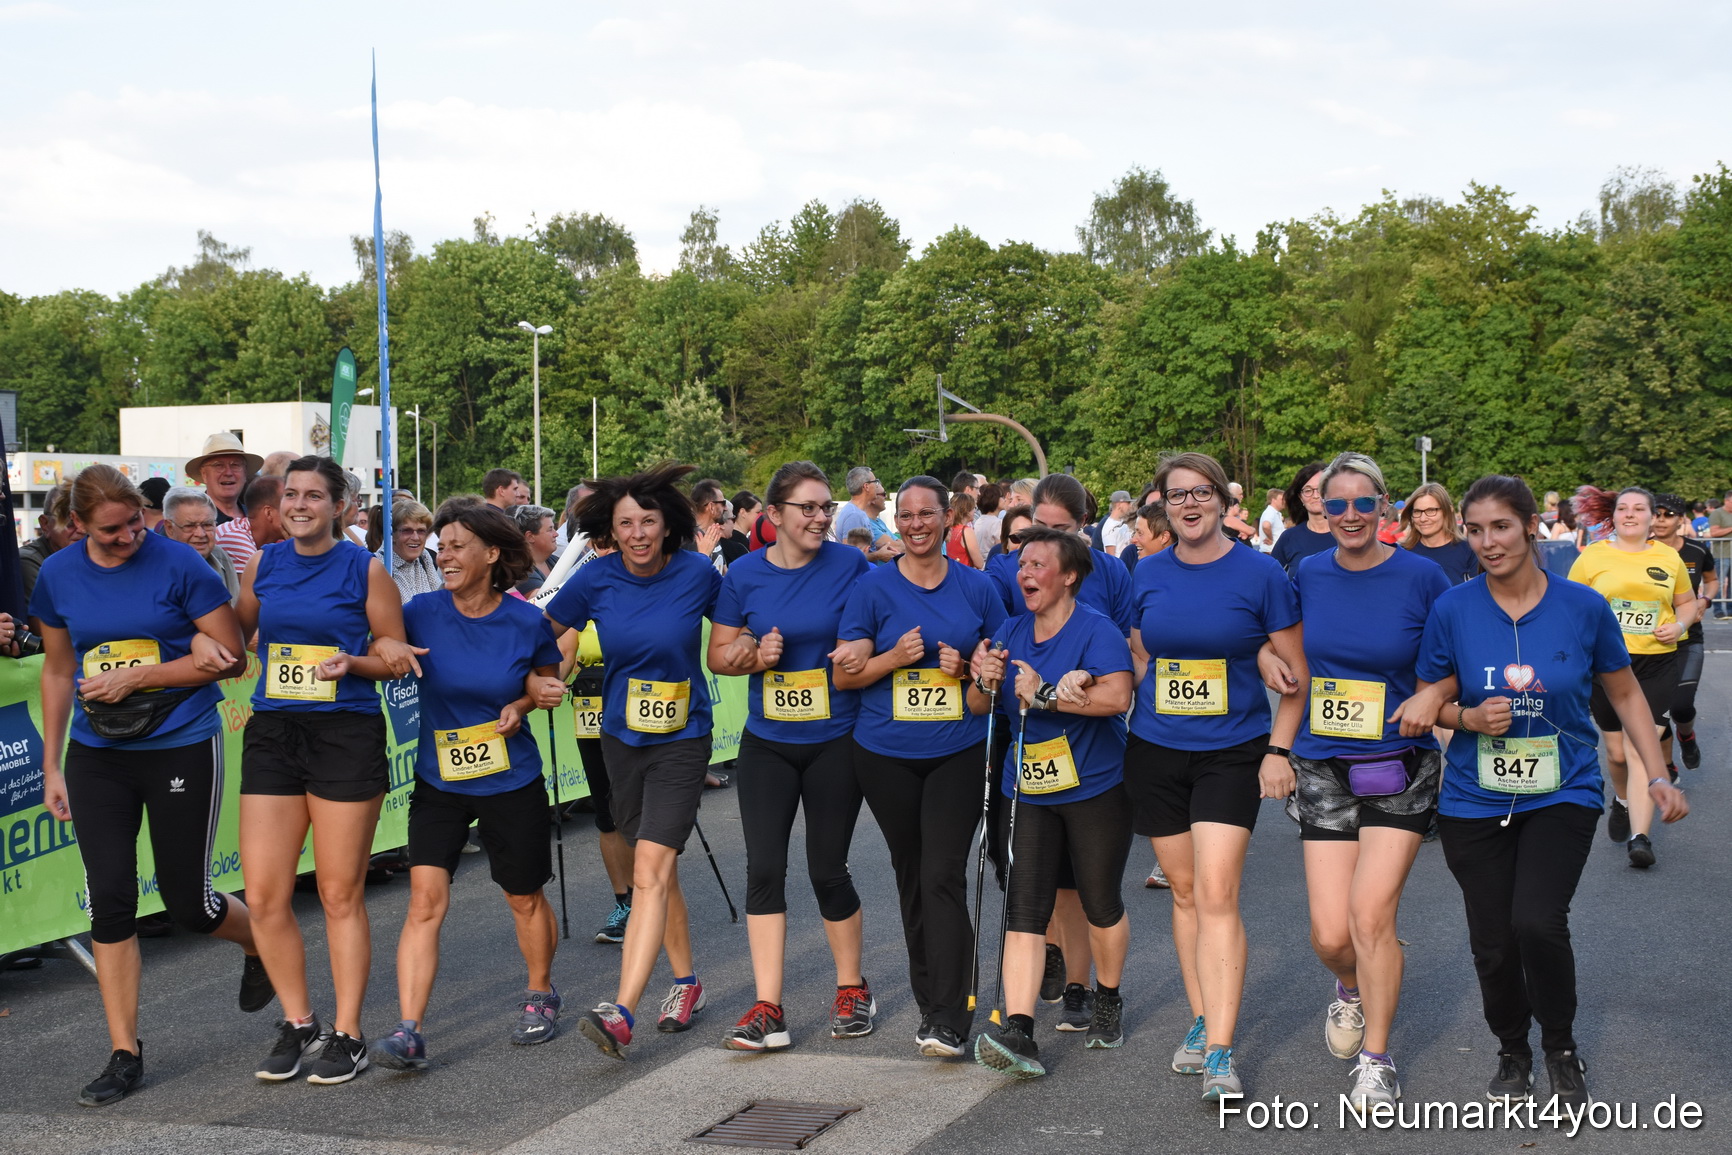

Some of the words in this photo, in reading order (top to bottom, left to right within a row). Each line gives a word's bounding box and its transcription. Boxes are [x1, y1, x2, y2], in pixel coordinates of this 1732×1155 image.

[1617, 612, 1652, 625] 1762
[279, 664, 316, 684] 861
[1484, 667, 1495, 689] I
[775, 689, 812, 707] 868
[908, 687, 946, 706] 872
[1169, 680, 1209, 699] 864
[639, 700, 676, 718] 866
[1323, 699, 1364, 722] 852
[450, 743, 490, 766] 862
[1022, 759, 1058, 780] 854
[1494, 757, 1539, 778] 847
